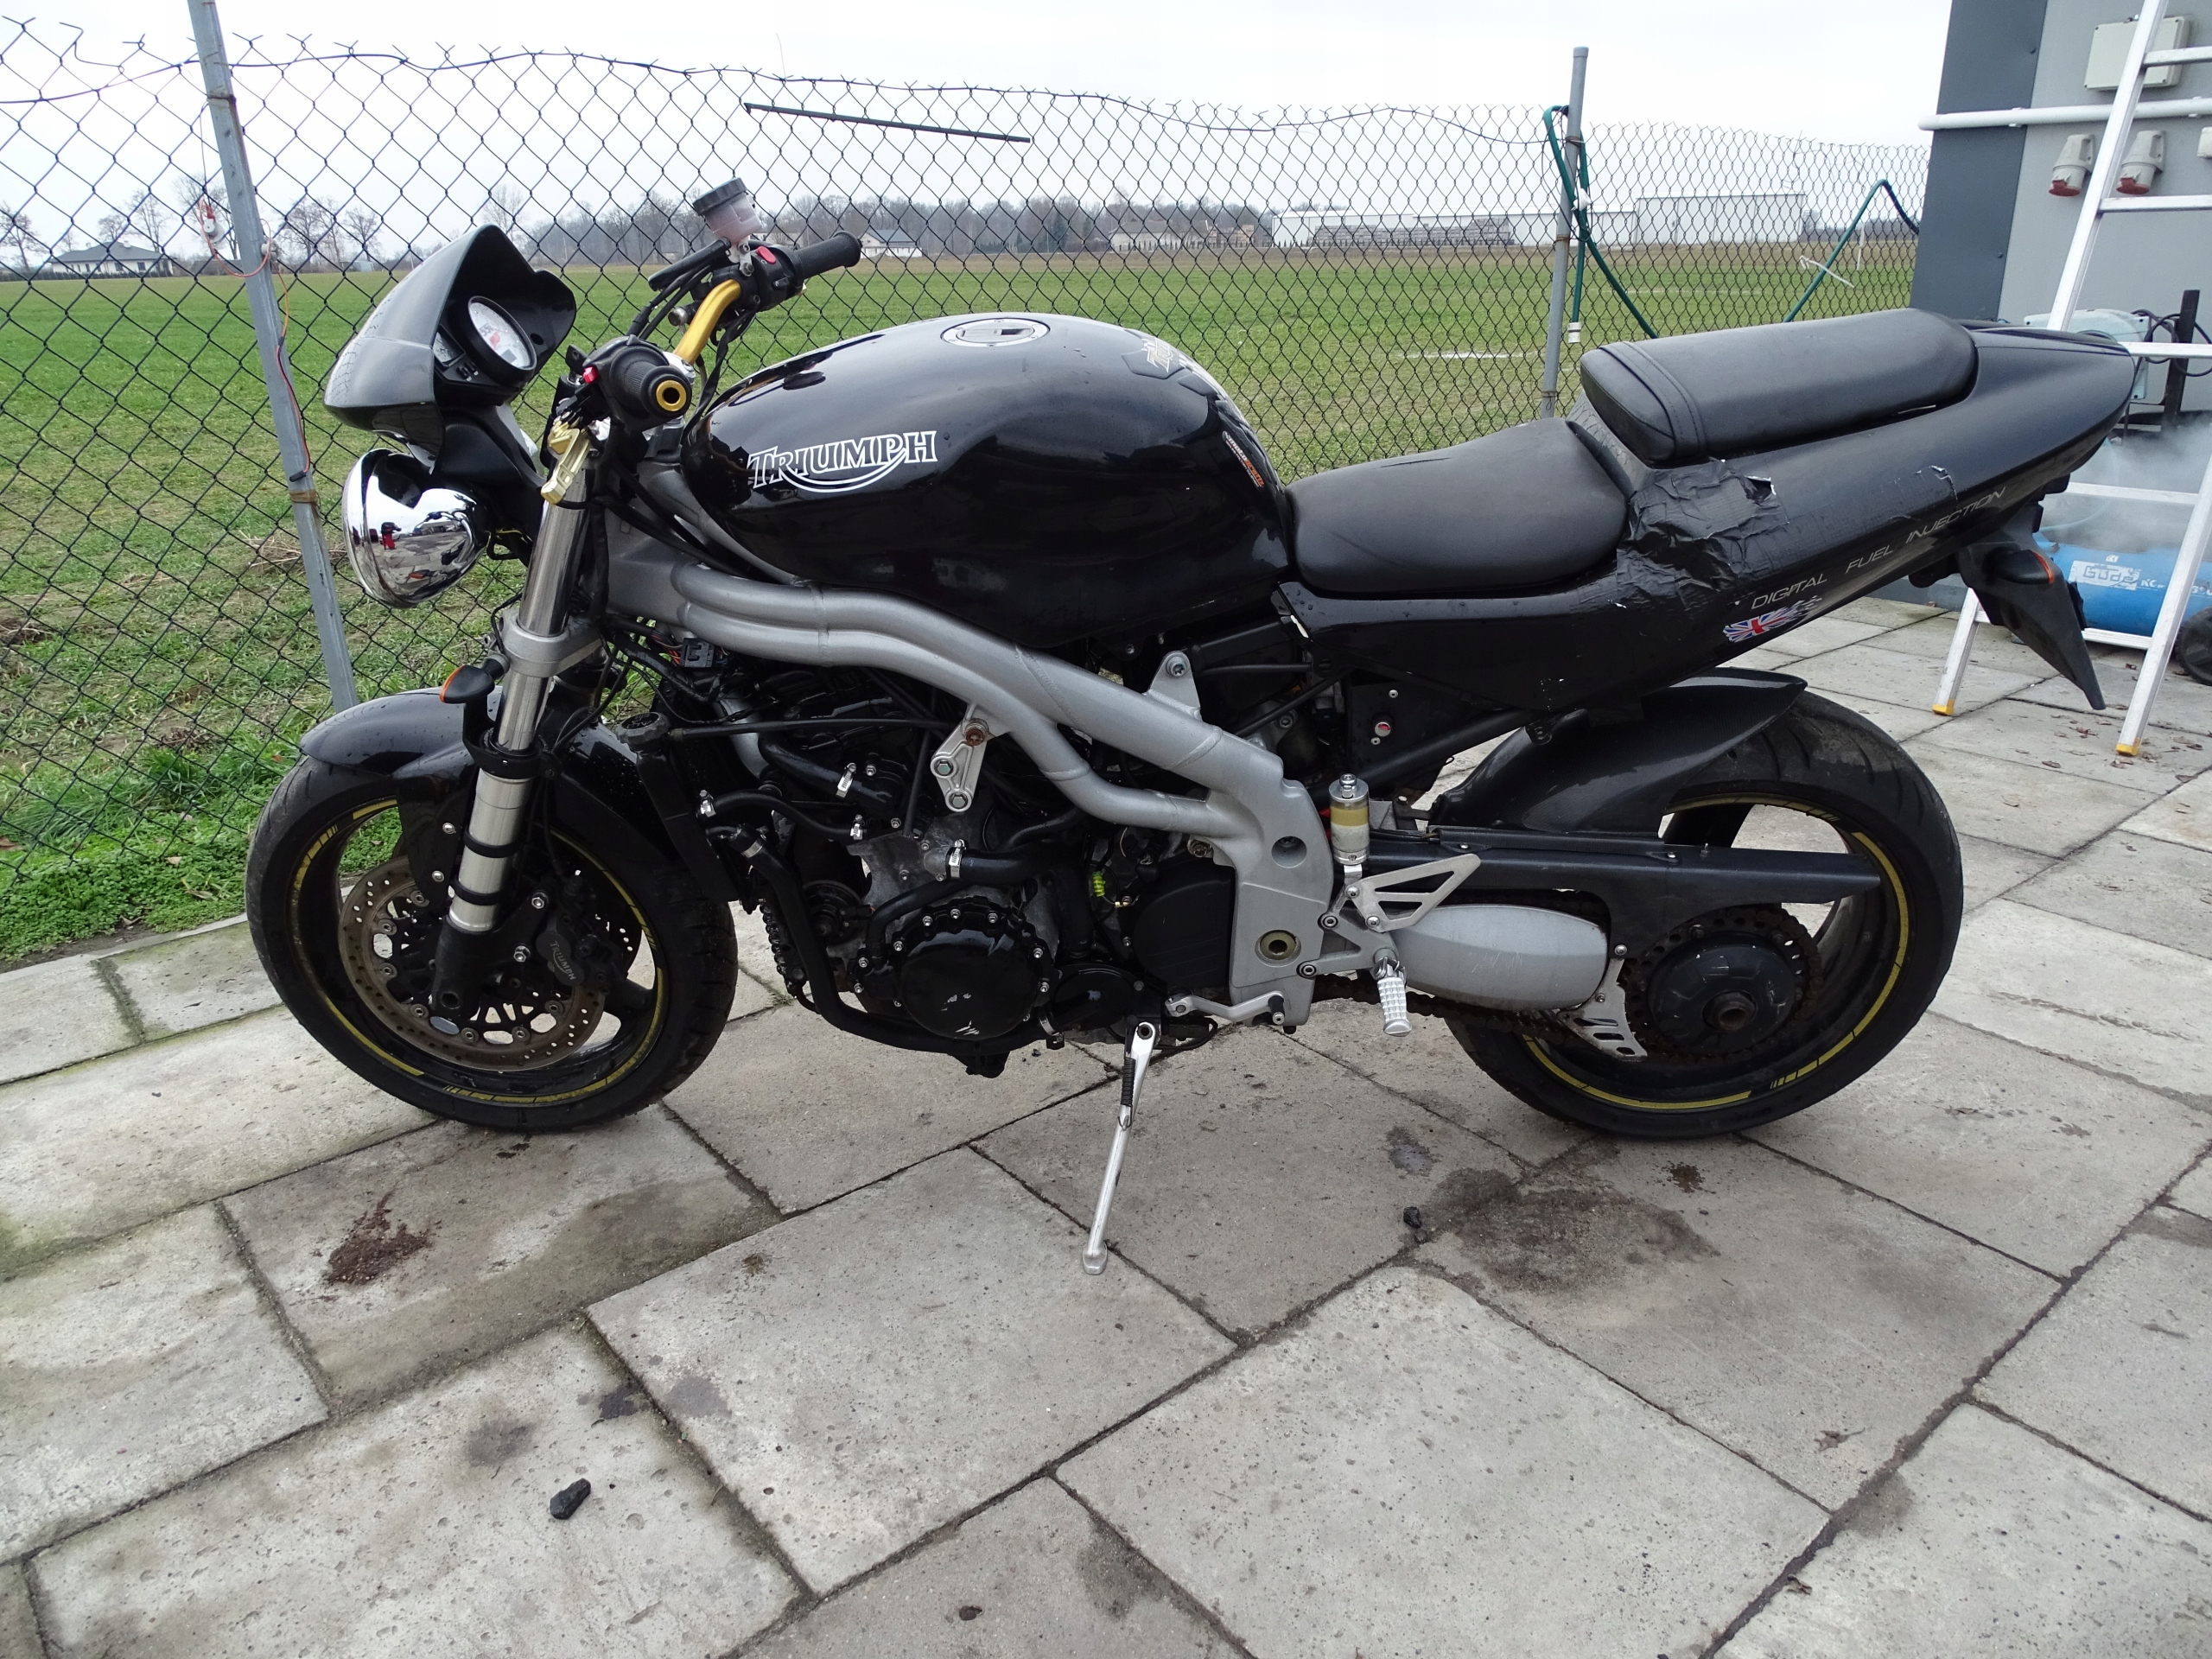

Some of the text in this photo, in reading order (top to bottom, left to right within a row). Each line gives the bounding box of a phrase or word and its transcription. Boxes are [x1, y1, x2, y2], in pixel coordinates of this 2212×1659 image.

[747, 430, 938, 493] TRIUMPH
[1751, 486, 2006, 610] DIGITAL FUEL INJECTION
[550, 940, 576, 980] TRIUMPH
